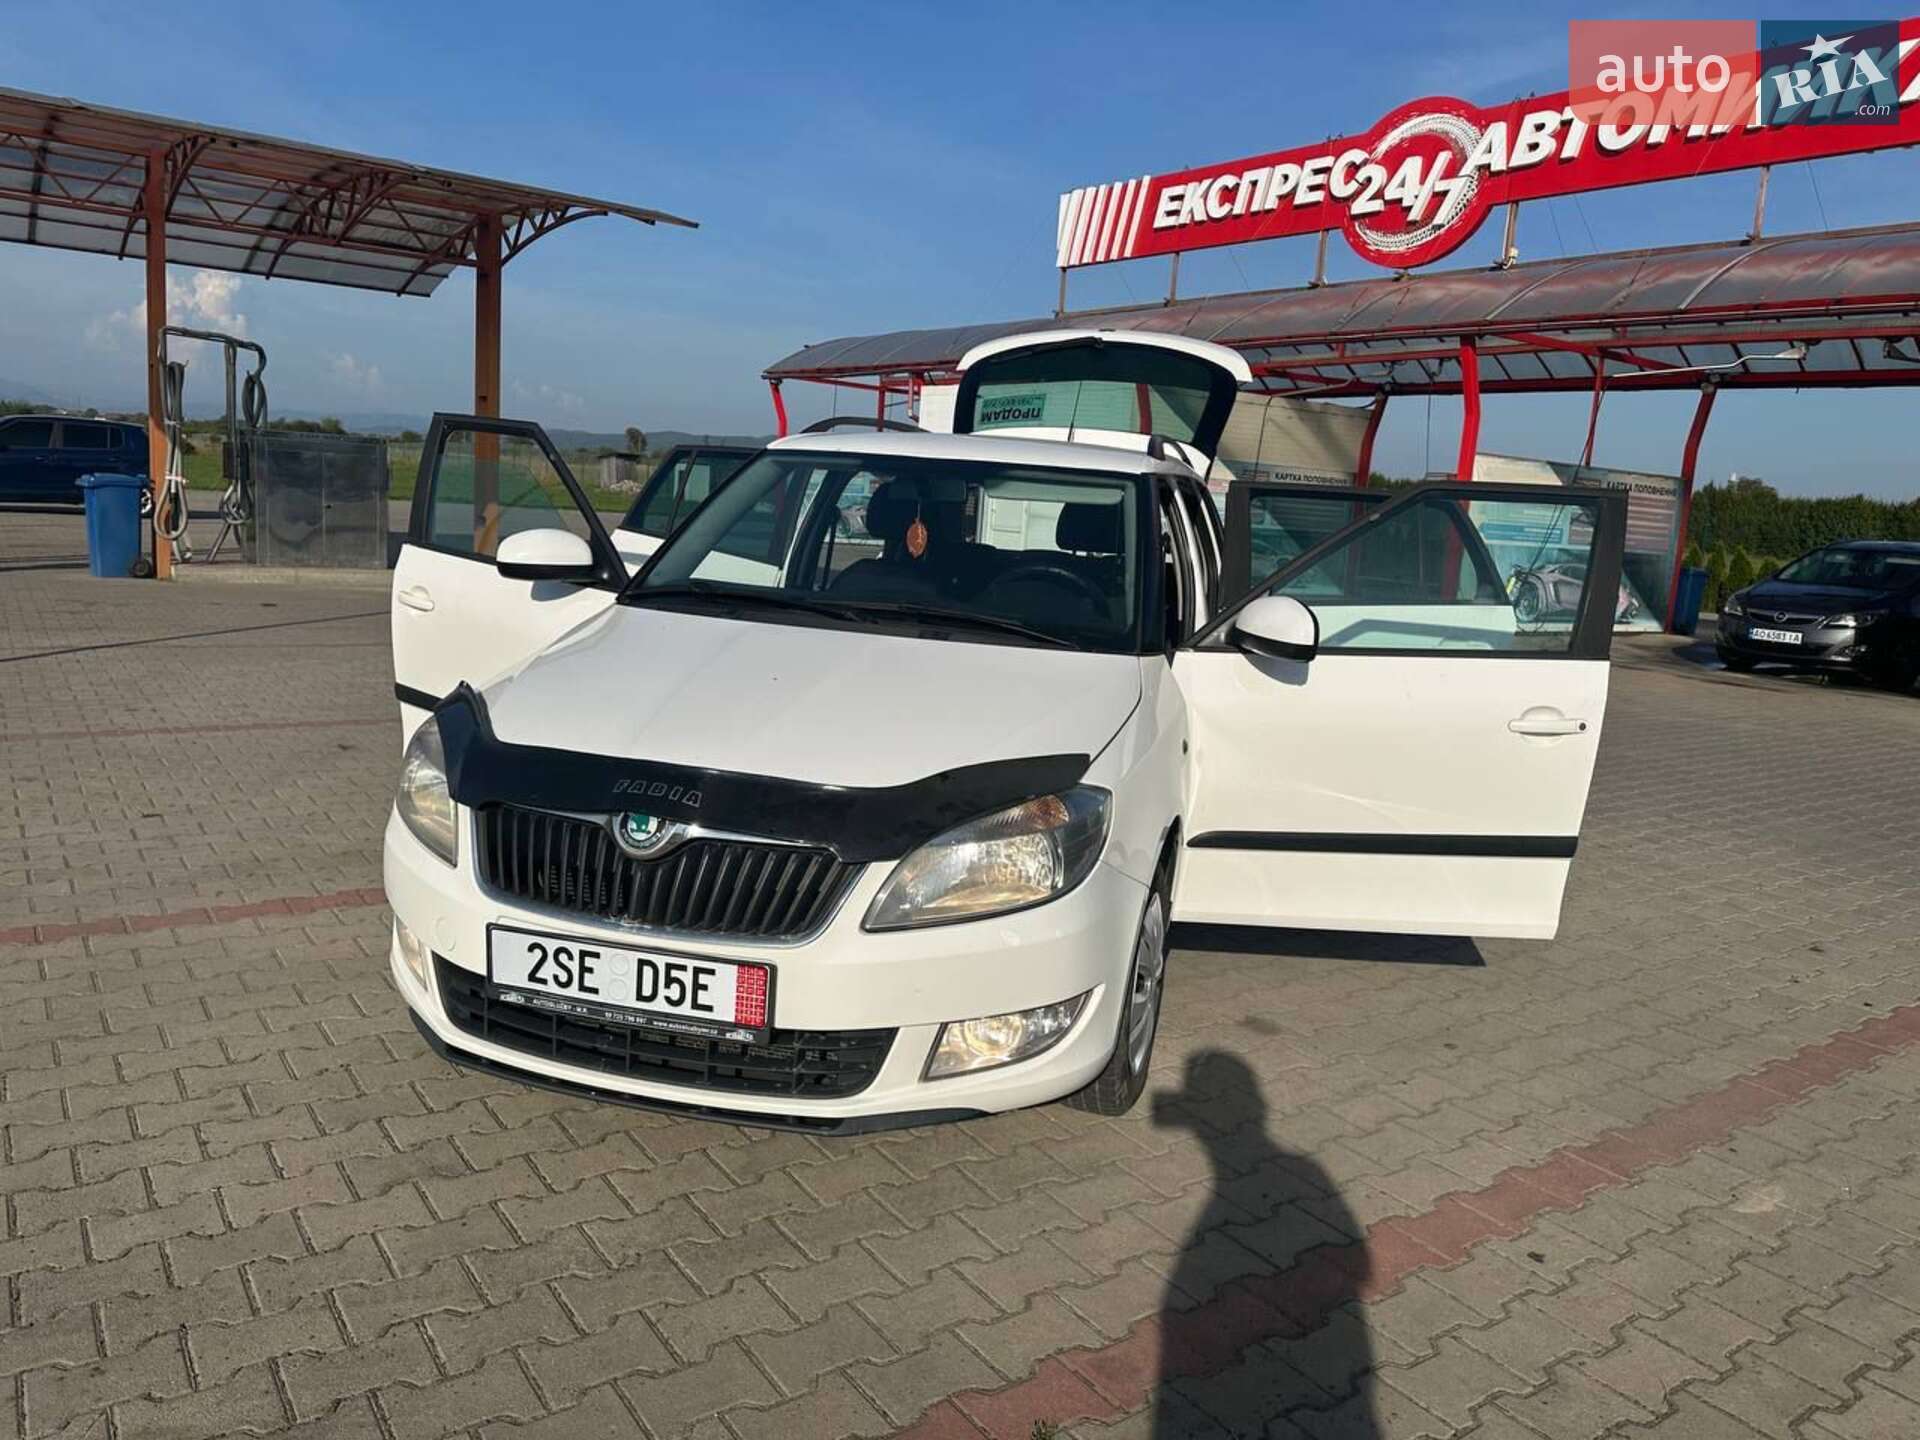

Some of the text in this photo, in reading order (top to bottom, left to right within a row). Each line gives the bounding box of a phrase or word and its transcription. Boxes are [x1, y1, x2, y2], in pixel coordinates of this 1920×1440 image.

[1153, 37, 1920, 230] ЕКСПРЕС 24/7 АВТОМИЙК
[981, 407, 1042, 422] ПРОДАМ
[612, 778, 703, 808] FABIA
[526, 941, 716, 1013] 2SE D5E
